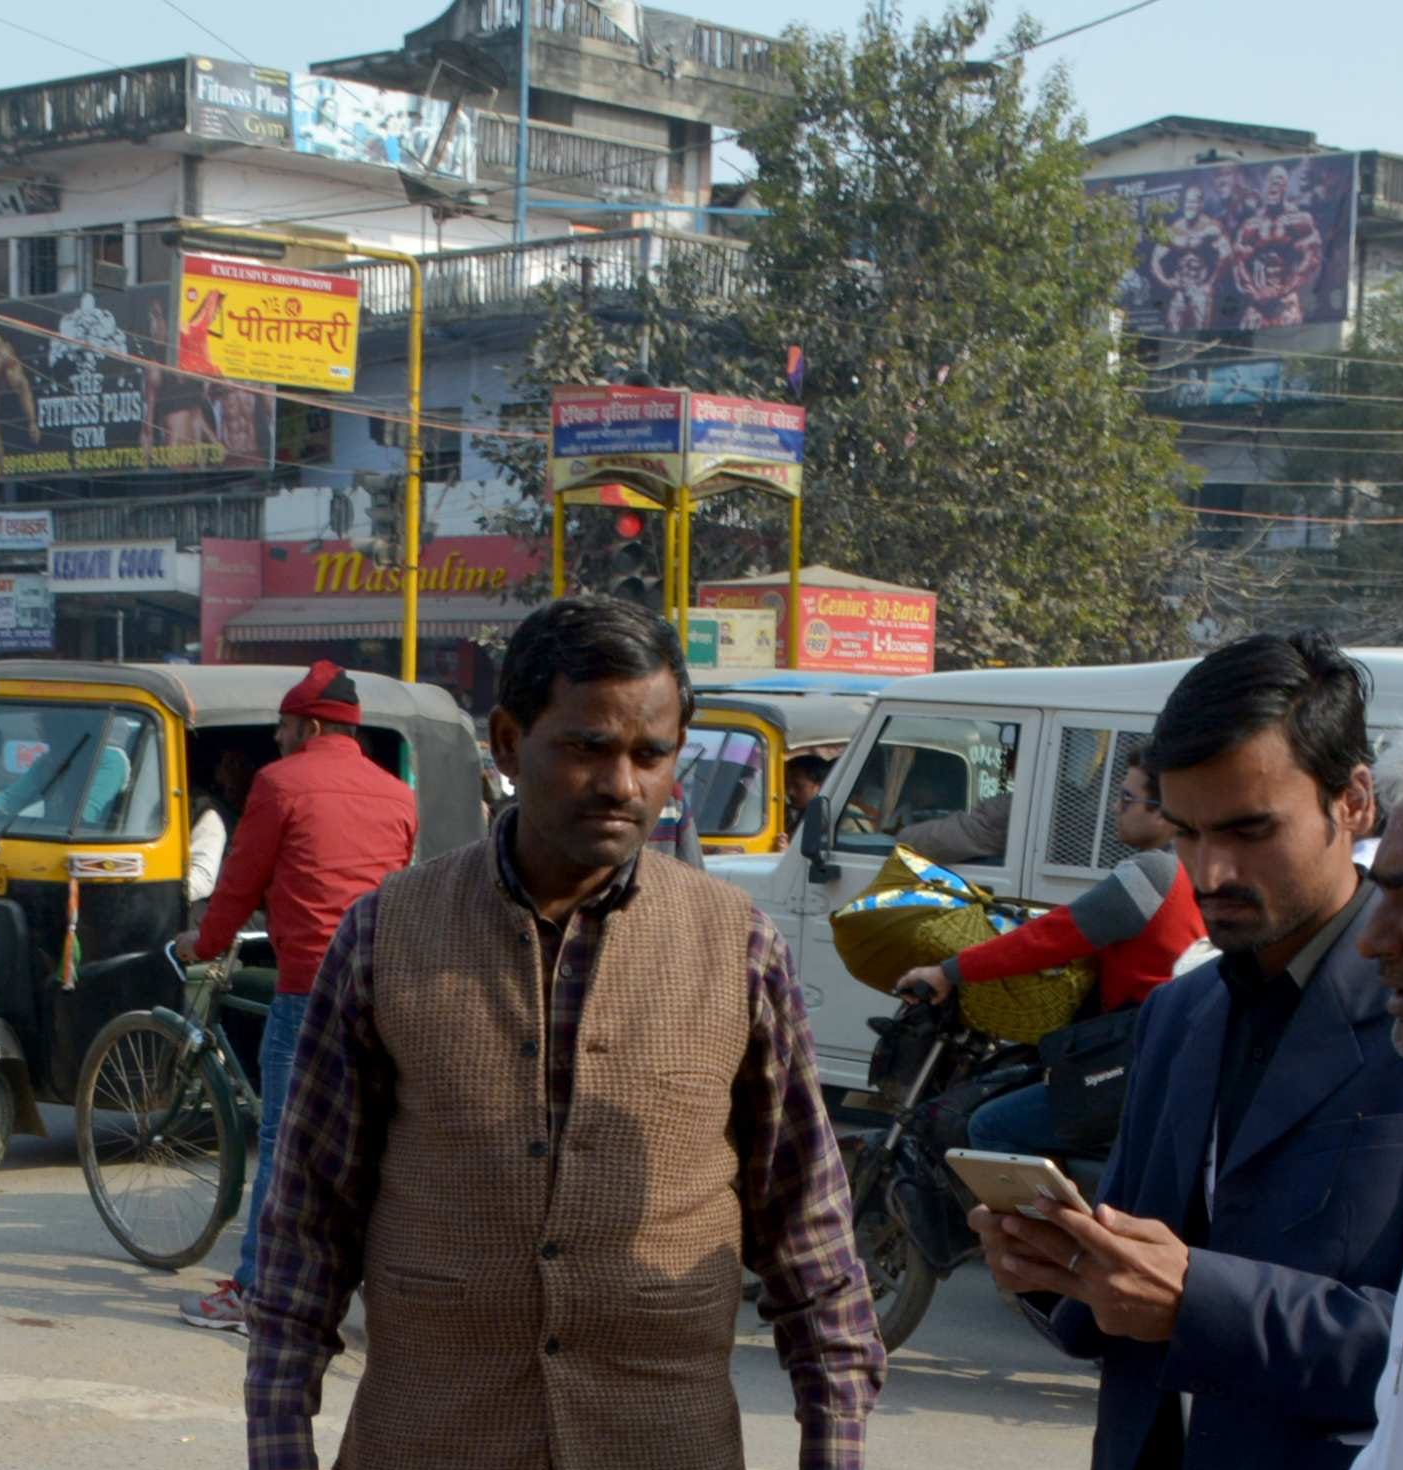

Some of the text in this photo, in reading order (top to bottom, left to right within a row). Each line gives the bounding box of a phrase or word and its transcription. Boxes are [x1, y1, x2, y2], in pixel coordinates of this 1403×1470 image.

[196, 74, 288, 115] Fitness Plus
[244, 113, 285, 140] Gym
[210, 263, 333, 292] EXCLUSIVE SHOWROOM
[227, 306, 352, 354] पीताम्बरी
[69, 372, 105, 393] THE
[37, 390, 144, 428] FITNESS PLUS
[643, 399, 677, 421] पोस्ट
[71, 426, 106, 449] GYM
[313, 550, 508, 593] Masuline
[818, 593, 868, 619] Genius
[806, 637, 828, 652] FREE
